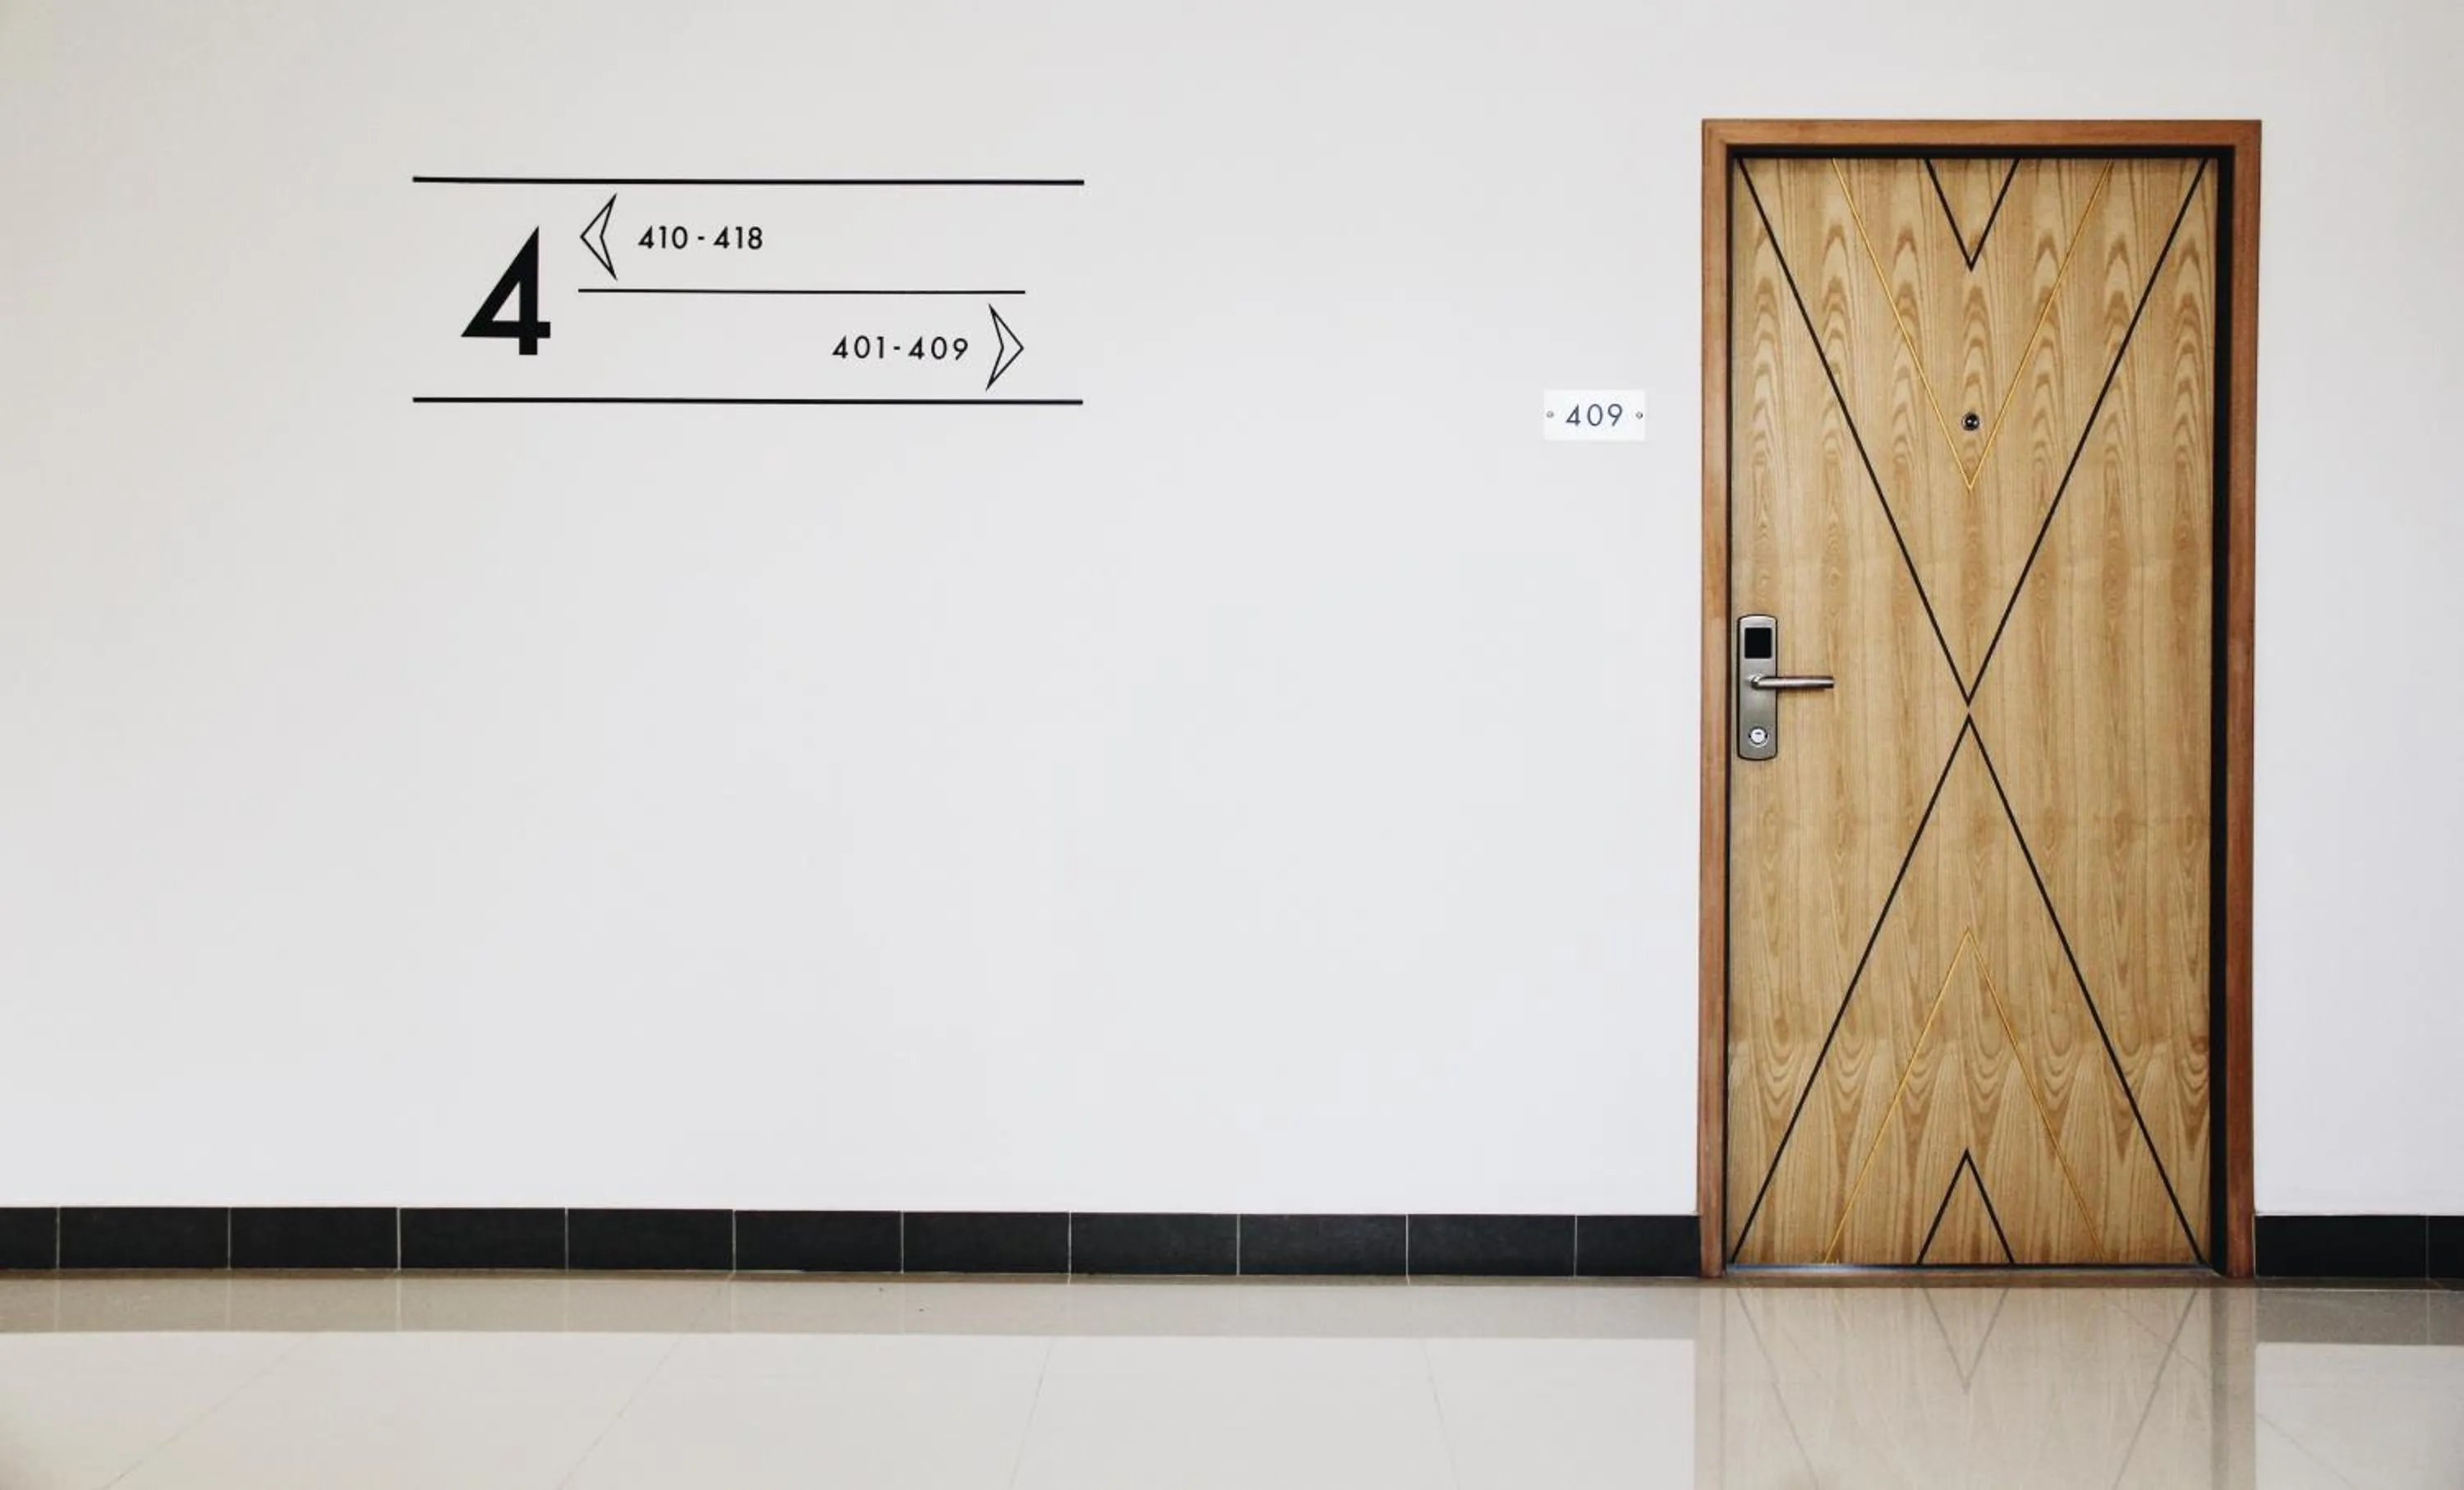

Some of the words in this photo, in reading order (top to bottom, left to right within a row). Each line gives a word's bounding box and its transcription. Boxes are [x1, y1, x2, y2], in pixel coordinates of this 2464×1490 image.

[637, 225, 688, 250] 410
[713, 226, 764, 251] 418
[460, 226, 551, 356] 4
[1565, 403, 1624, 426] 409
